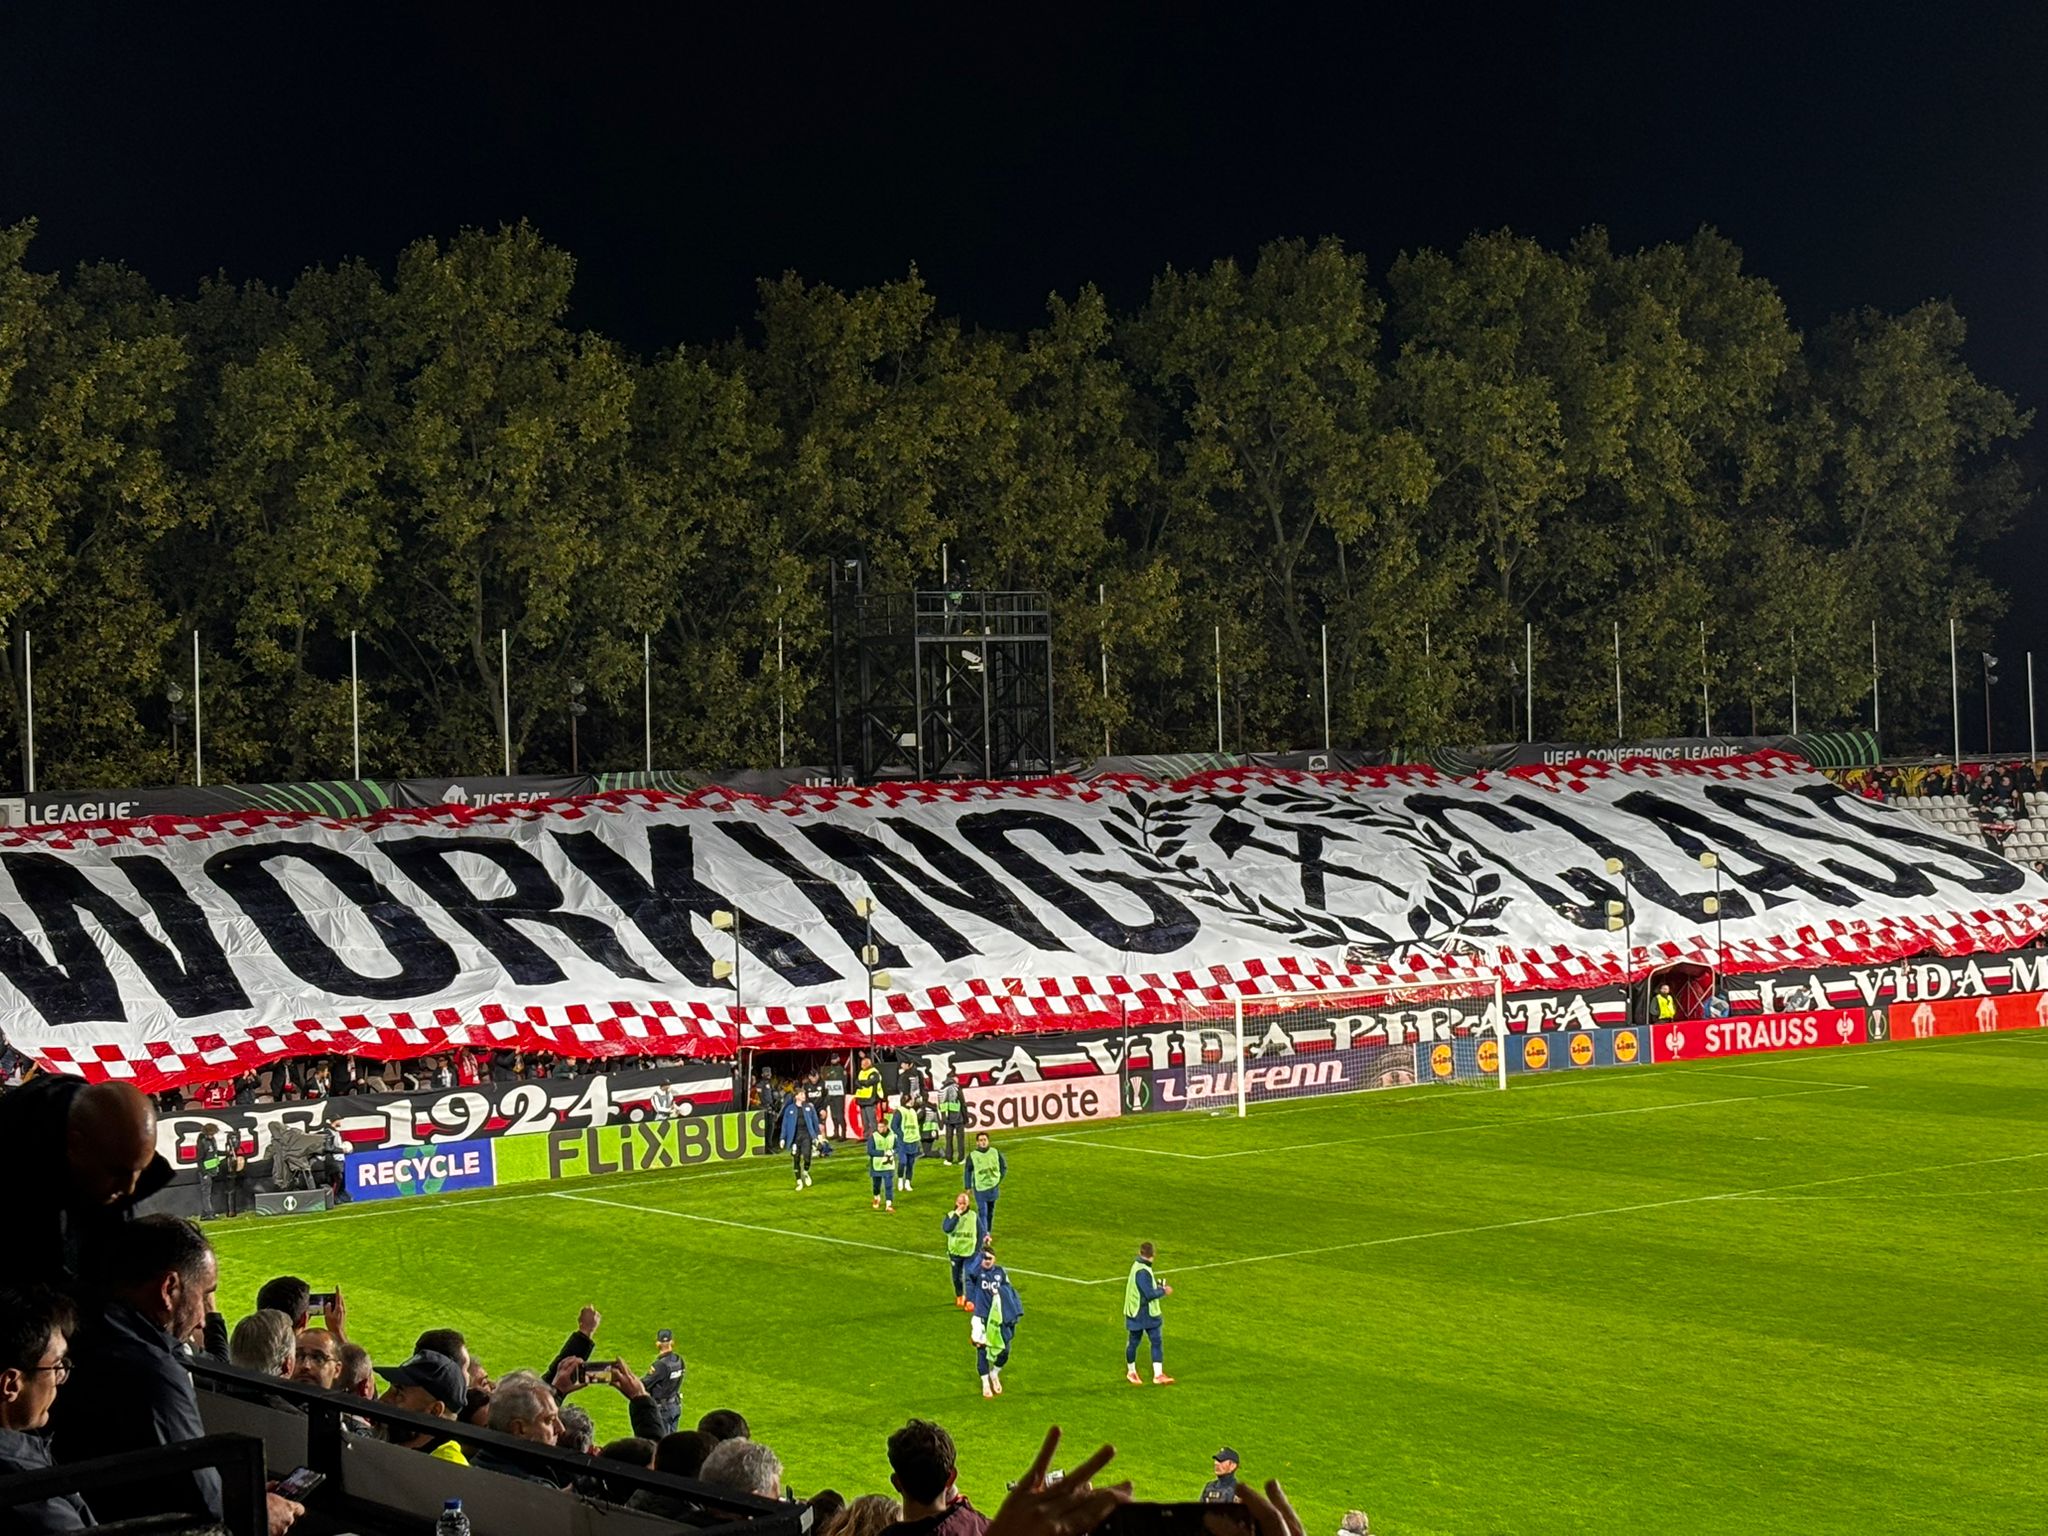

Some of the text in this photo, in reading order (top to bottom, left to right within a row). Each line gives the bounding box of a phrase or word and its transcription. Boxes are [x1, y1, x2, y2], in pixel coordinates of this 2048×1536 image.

[0, 782, 2026, 1027] WORKING CLASS
[1849, 959, 1992, 1007] VIDA
[1077, 1022, 1297, 1075] VIDA
[1326, 994, 1601, 1051] PIRATA
[1704, 1016, 1819, 1053] STRAUSS
[965, 1084, 1099, 1127] ssquote
[358, 1151, 480, 1187] RECYCLE
